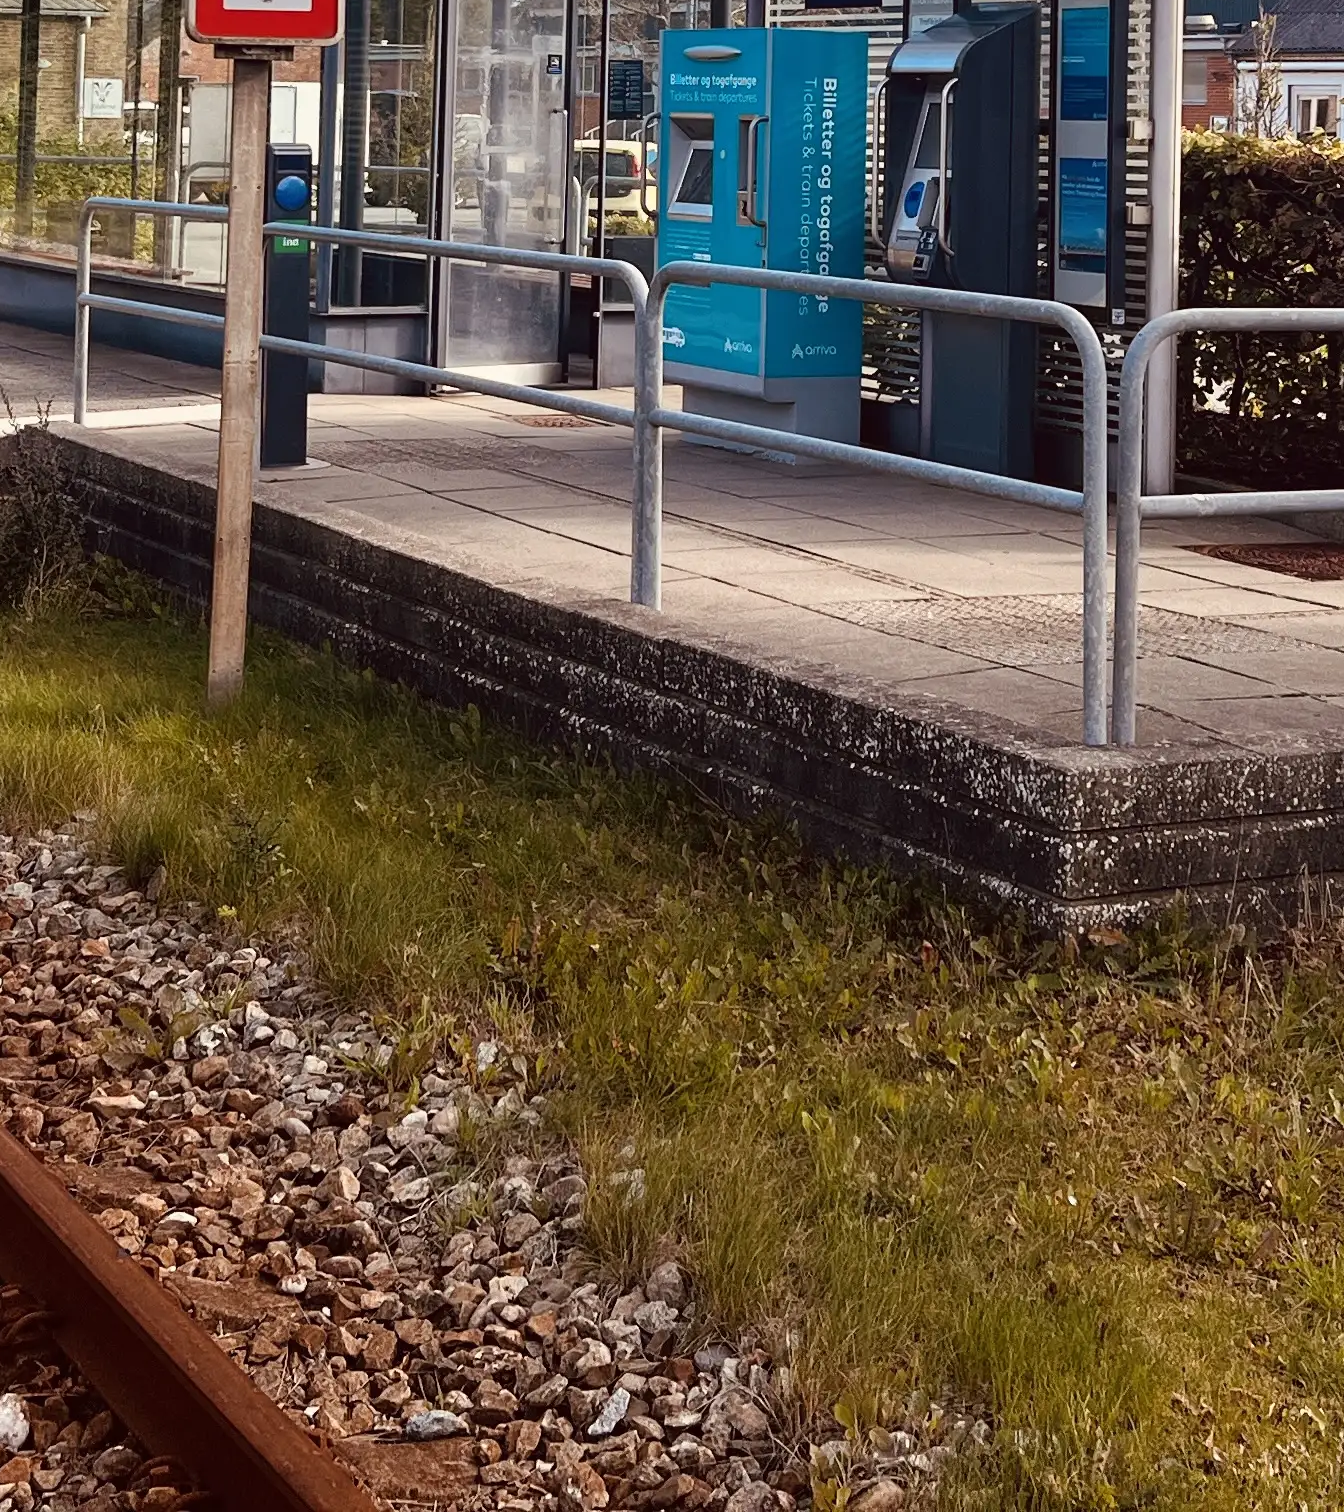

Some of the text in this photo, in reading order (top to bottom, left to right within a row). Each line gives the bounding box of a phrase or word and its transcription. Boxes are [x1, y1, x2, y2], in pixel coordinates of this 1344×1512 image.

[701, 76, 711, 89] og
[802, 77, 817, 141] Tickets
[821, 78, 837, 159] Billetter
[802, 146, 816, 159] &
[801, 164, 813, 208] train
[817, 164, 832, 189] og
[805, 345, 837, 355] arriva
